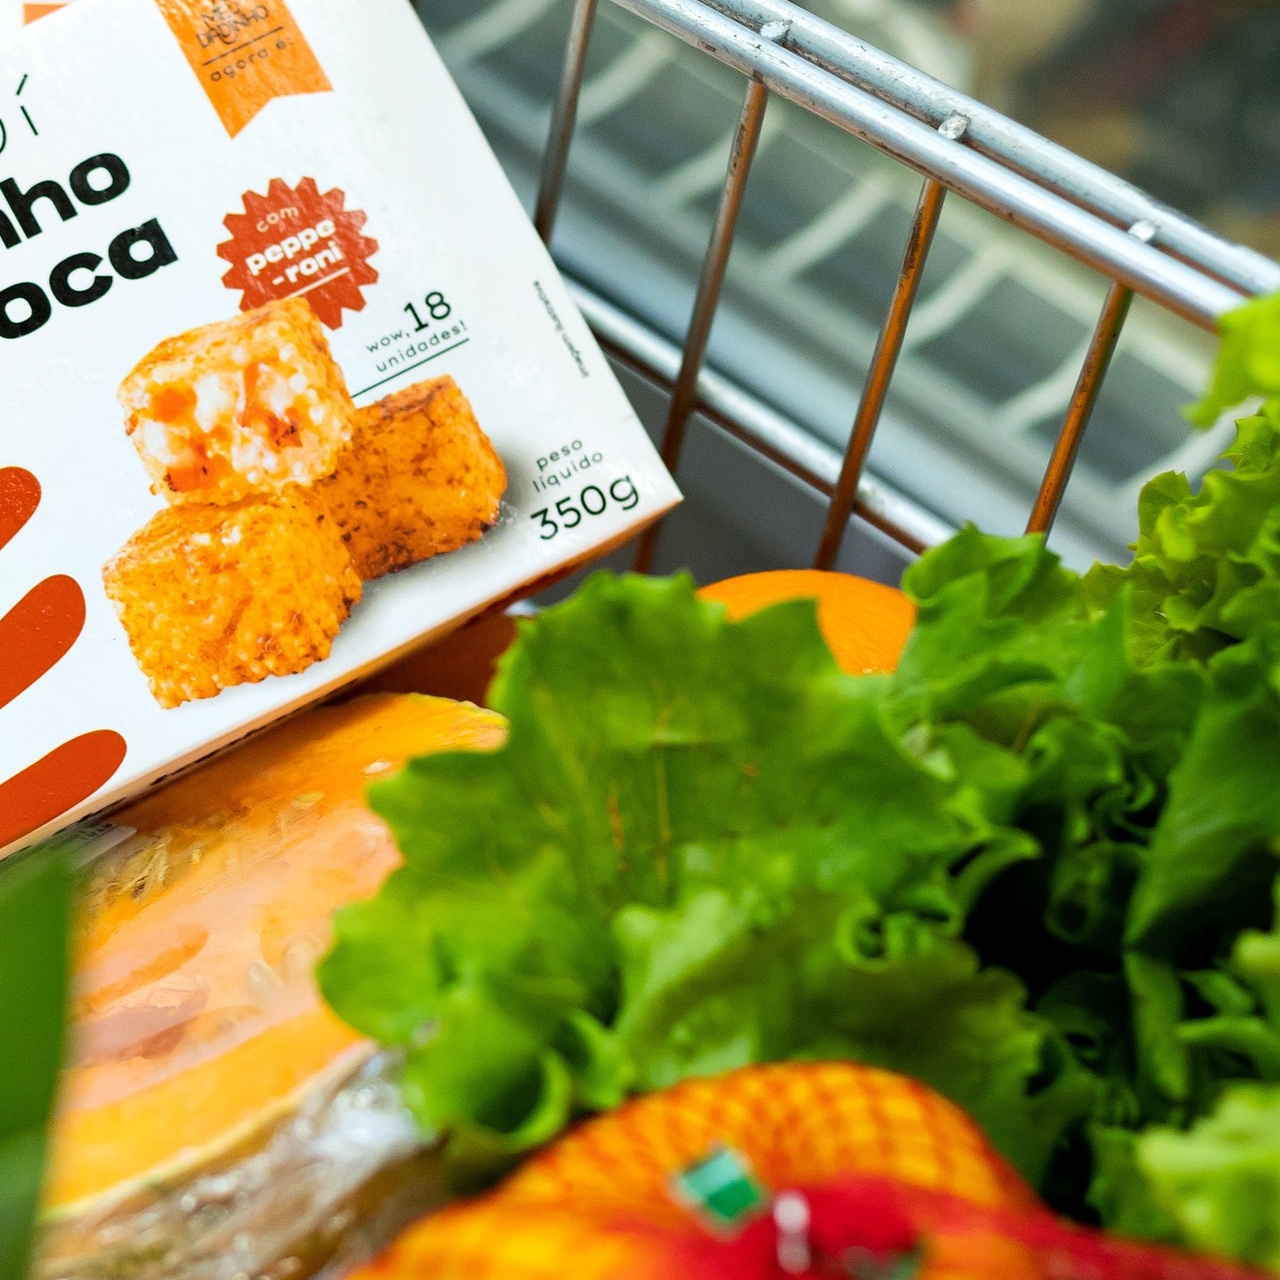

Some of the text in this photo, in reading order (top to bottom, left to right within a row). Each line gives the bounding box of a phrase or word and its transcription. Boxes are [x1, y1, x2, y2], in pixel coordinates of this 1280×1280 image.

[210, 48, 268, 82] agora
[255, 206, 300, 233] com
[245, 219, 337, 276] peppe
[403, 291, 452, 332] 18
[375, 320, 469, 373] unidades!
[532, 451, 604, 493] líquido
[535, 439, 583, 471] peso
[530, 474, 640, 541] 350g
